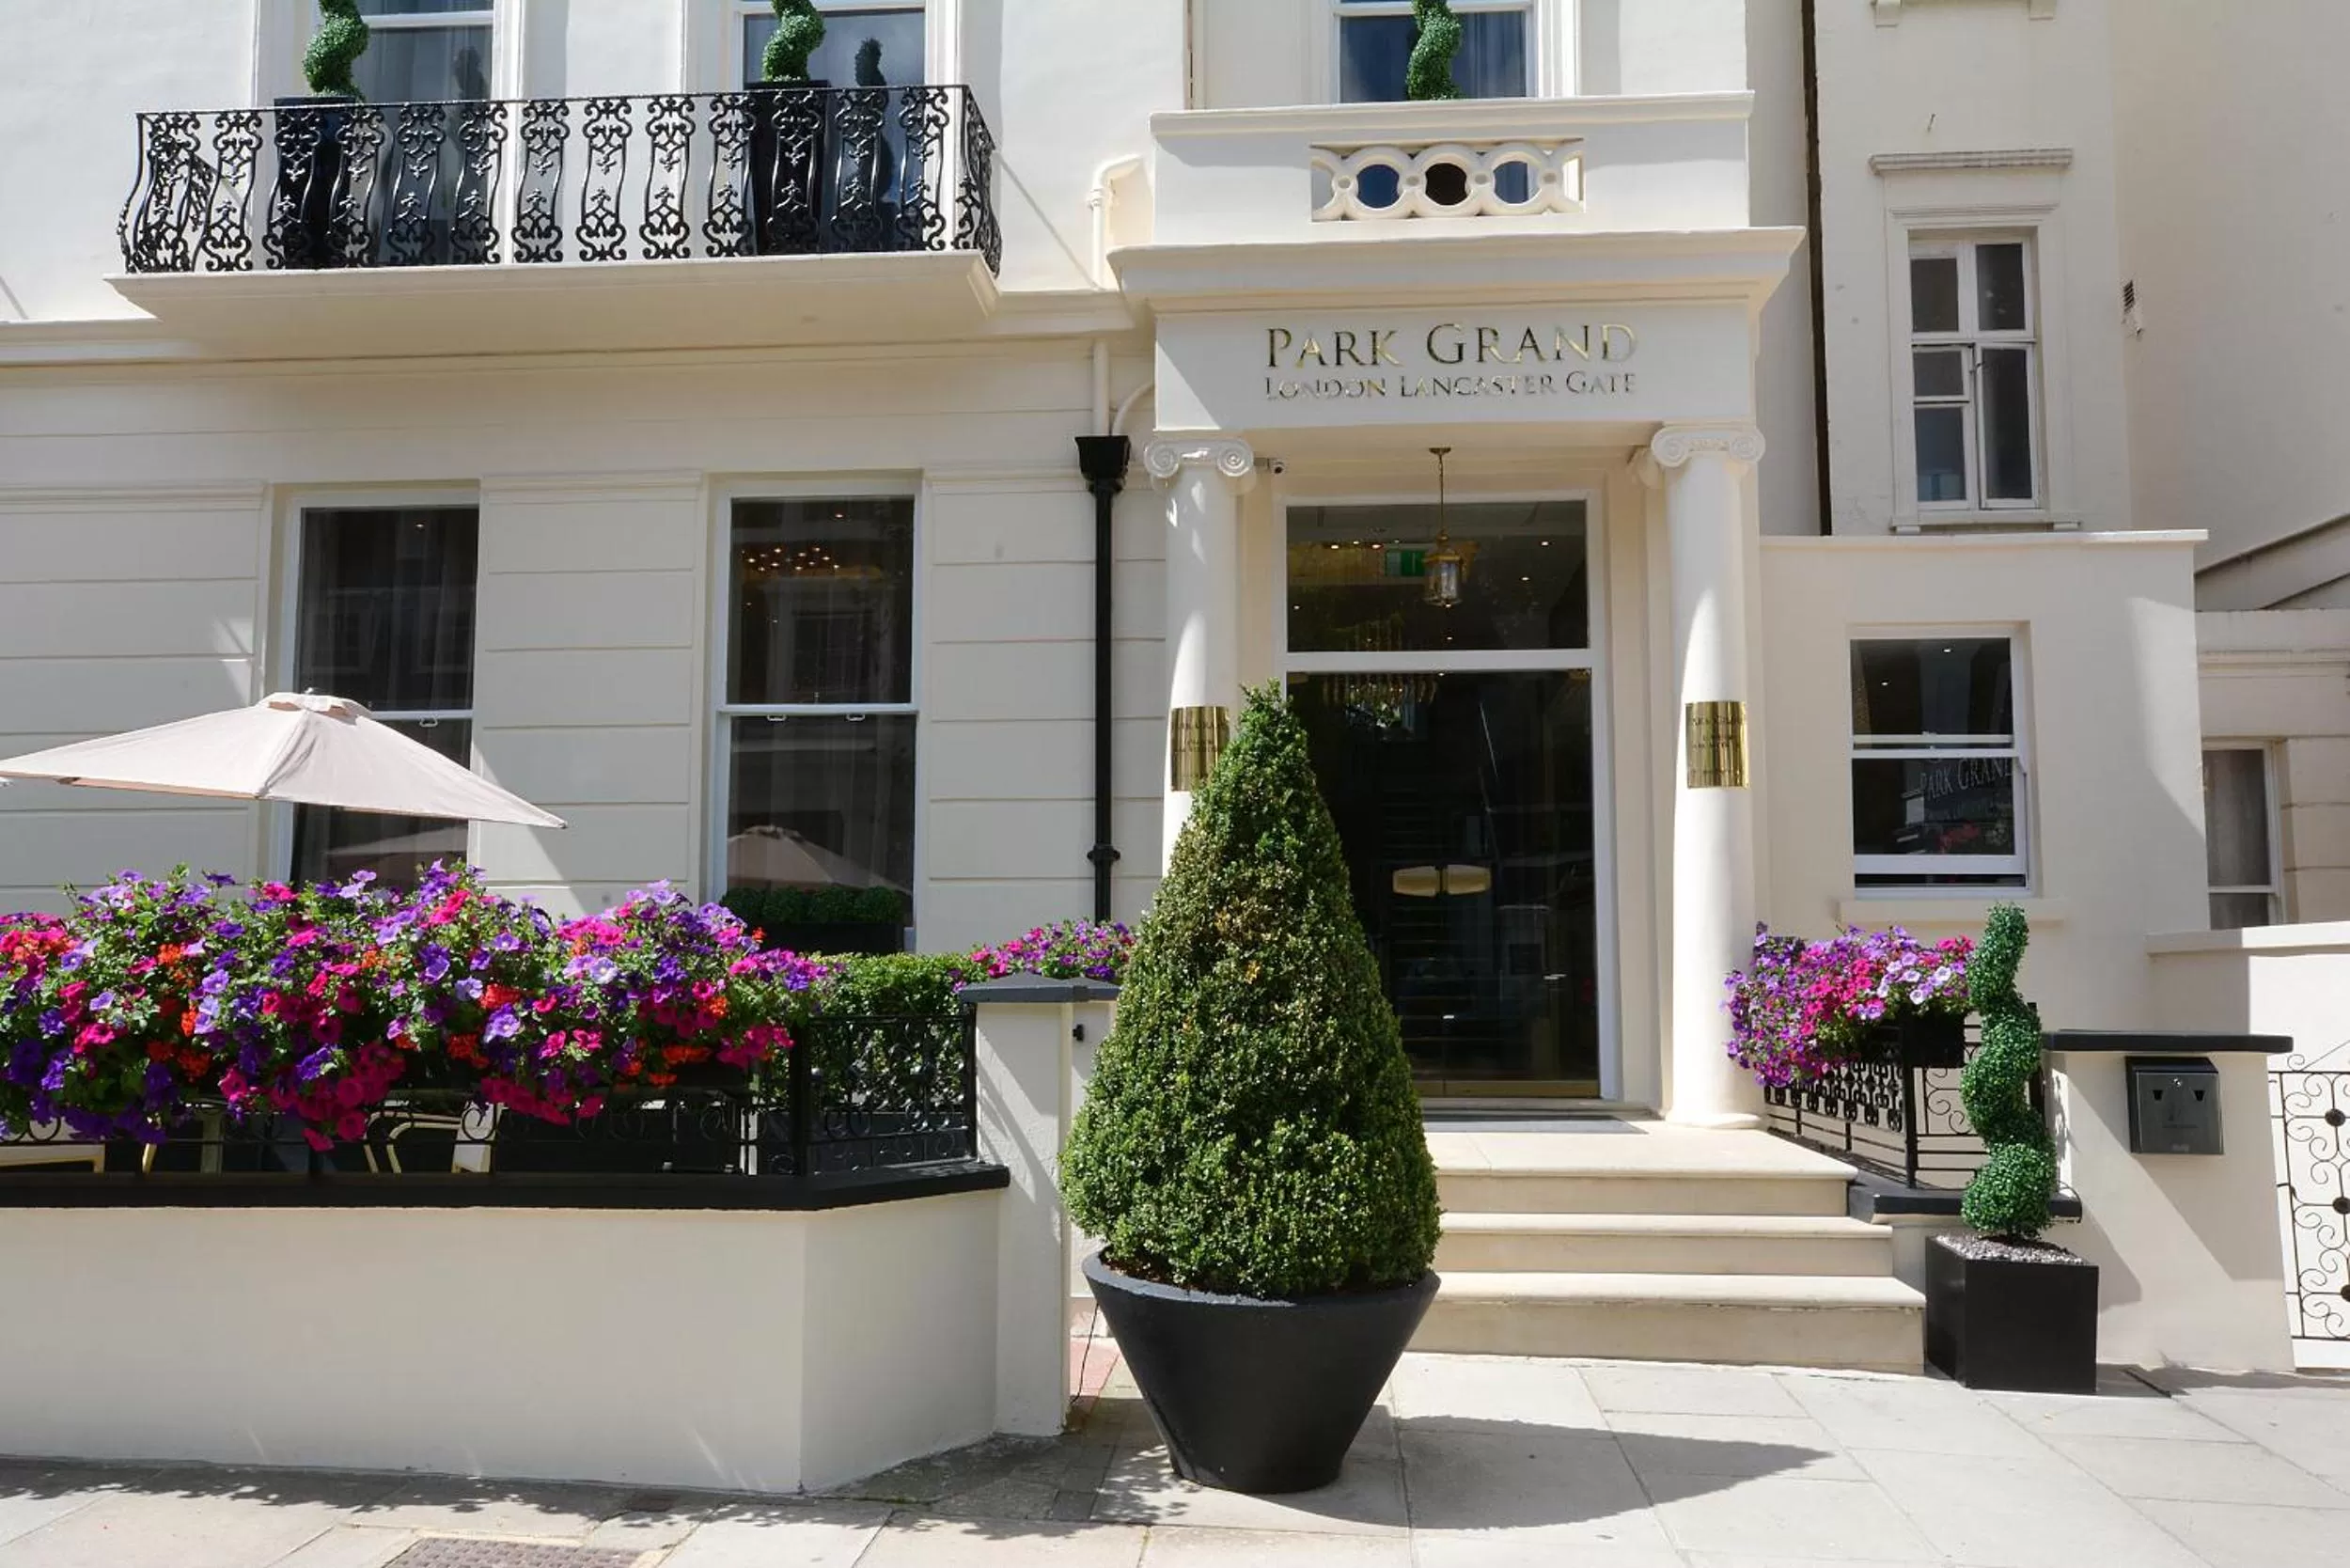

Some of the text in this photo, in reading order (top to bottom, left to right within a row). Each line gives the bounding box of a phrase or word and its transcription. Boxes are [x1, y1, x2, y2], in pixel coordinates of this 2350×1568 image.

[1265, 322, 1638, 368] PARK GRAND
[1265, 369, 1637, 400] LONDON LANCASTER GATE
